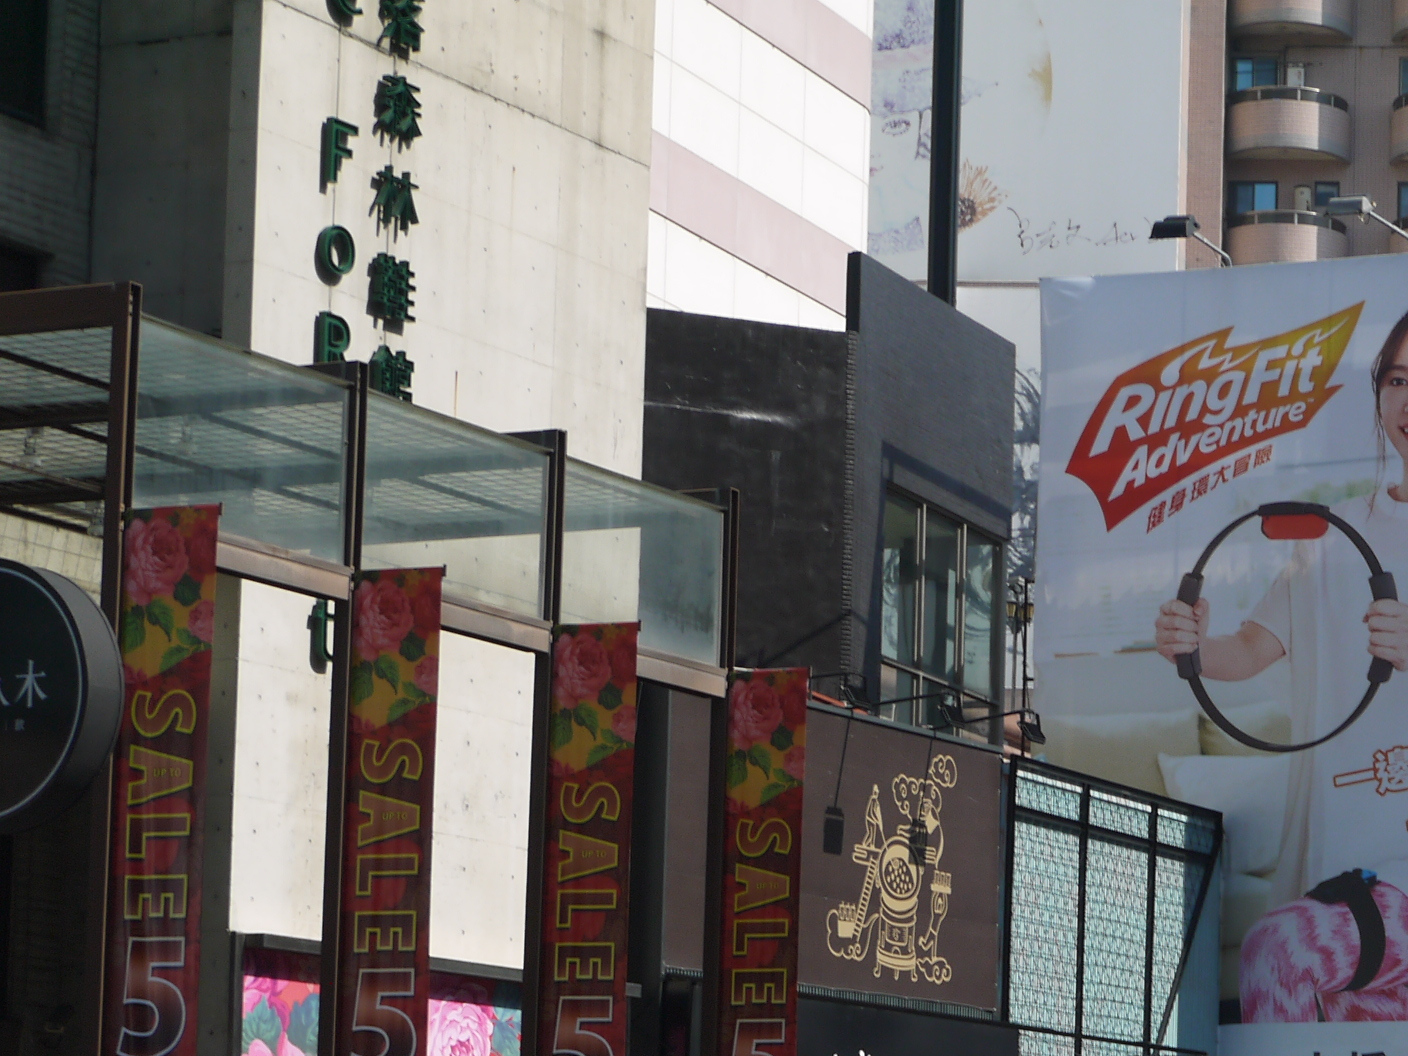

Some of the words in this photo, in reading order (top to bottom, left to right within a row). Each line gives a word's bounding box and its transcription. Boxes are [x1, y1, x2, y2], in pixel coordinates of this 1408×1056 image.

[1107, 400, 1307, 503] Adventure
[1146, 444, 1273, 535] 健身環大冒險
[124, 689, 196, 920] SALE
[354, 737, 423, 954] SALE
[554, 782, 621, 983] SALE
[732, 818, 793, 1006] SALE
